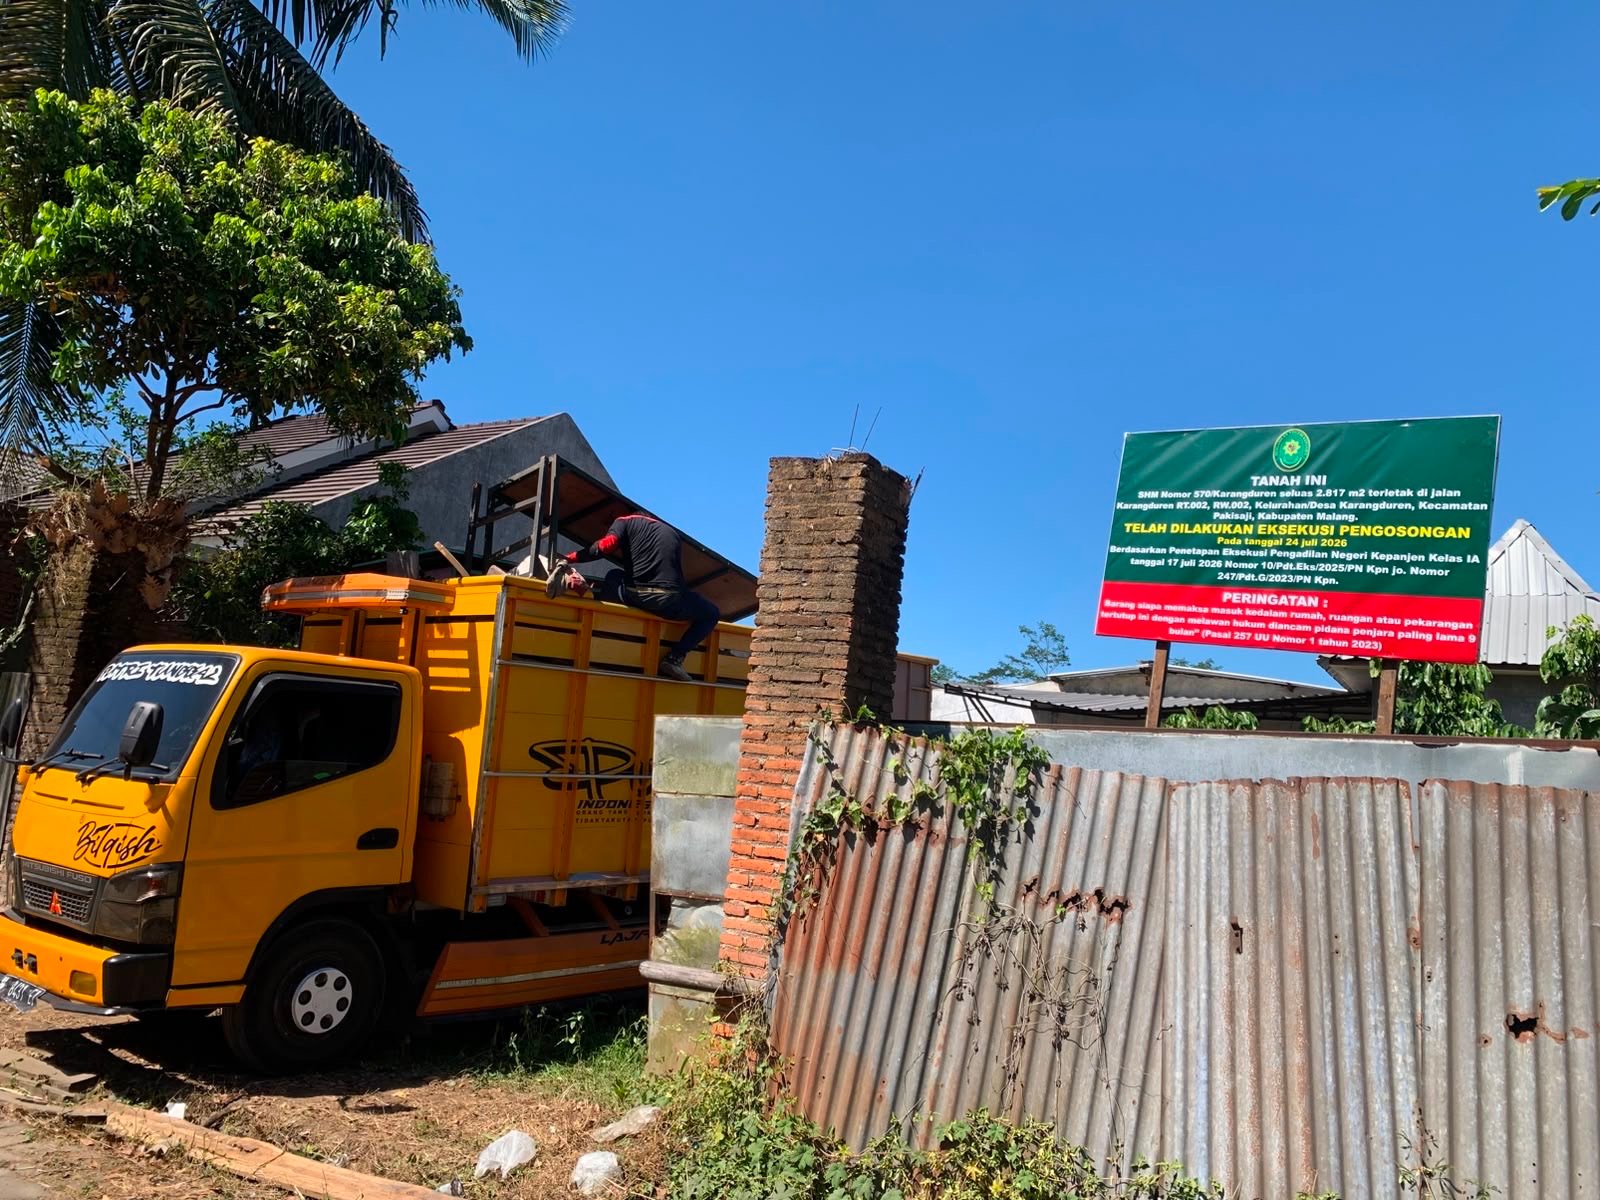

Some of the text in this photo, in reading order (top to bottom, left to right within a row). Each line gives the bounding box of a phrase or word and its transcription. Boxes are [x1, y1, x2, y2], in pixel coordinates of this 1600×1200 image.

[1250, 474, 1327, 487] TANAH INI
[1138, 488, 1461, 500] SHM Nomor 570/Karangduren seluas 2.817 m2 terletak di jalan
[1116, 500, 1488, 512] Karangduren RT.002, RW.002, Kelurahan/Desa Karangduren, Kecamatan
[1212, 512, 1358, 522] Pakisaji, Kabupaten Malang.
[1123, 522, 1471, 539] TELAH DILAKUKAN EKSEKUSI PENGOSONGAN
[1217, 537, 1348, 548] Pada tanggal 24 juli 2026
[1109, 545, 1481, 564] Berdasarkan Penetapan Eksekusi Pengadilan Negeri Kepanjen Kelas IA
[1130, 557, 1450, 577] tanggal 17 juli 2026 Nomor 10/Pdt.Eks/2025/PN Kpn jo. Nomor
[1217, 572, 1340, 586] 247/Pdt.G/2023/PN Kpn.
[1222, 592, 1319, 608] PERINGATAN
[1104, 599, 1474, 630] Barang siapa memaksa masuk kedalam rumah, ruangan atau pekarangan
[1100, 610, 1477, 644] tertutup ini dengan melawan hukum diancam pidana penjara paling lama 9
[1201, 629, 1232, 640] (Pasal
[1233, 631, 1251, 641] 257
[1254, 632, 1270, 642] UU
[1272, 634, 1307, 645] Nomor
[1317, 638, 1349, 649] tahun
[1351, 640, 1383, 651] 2023)
